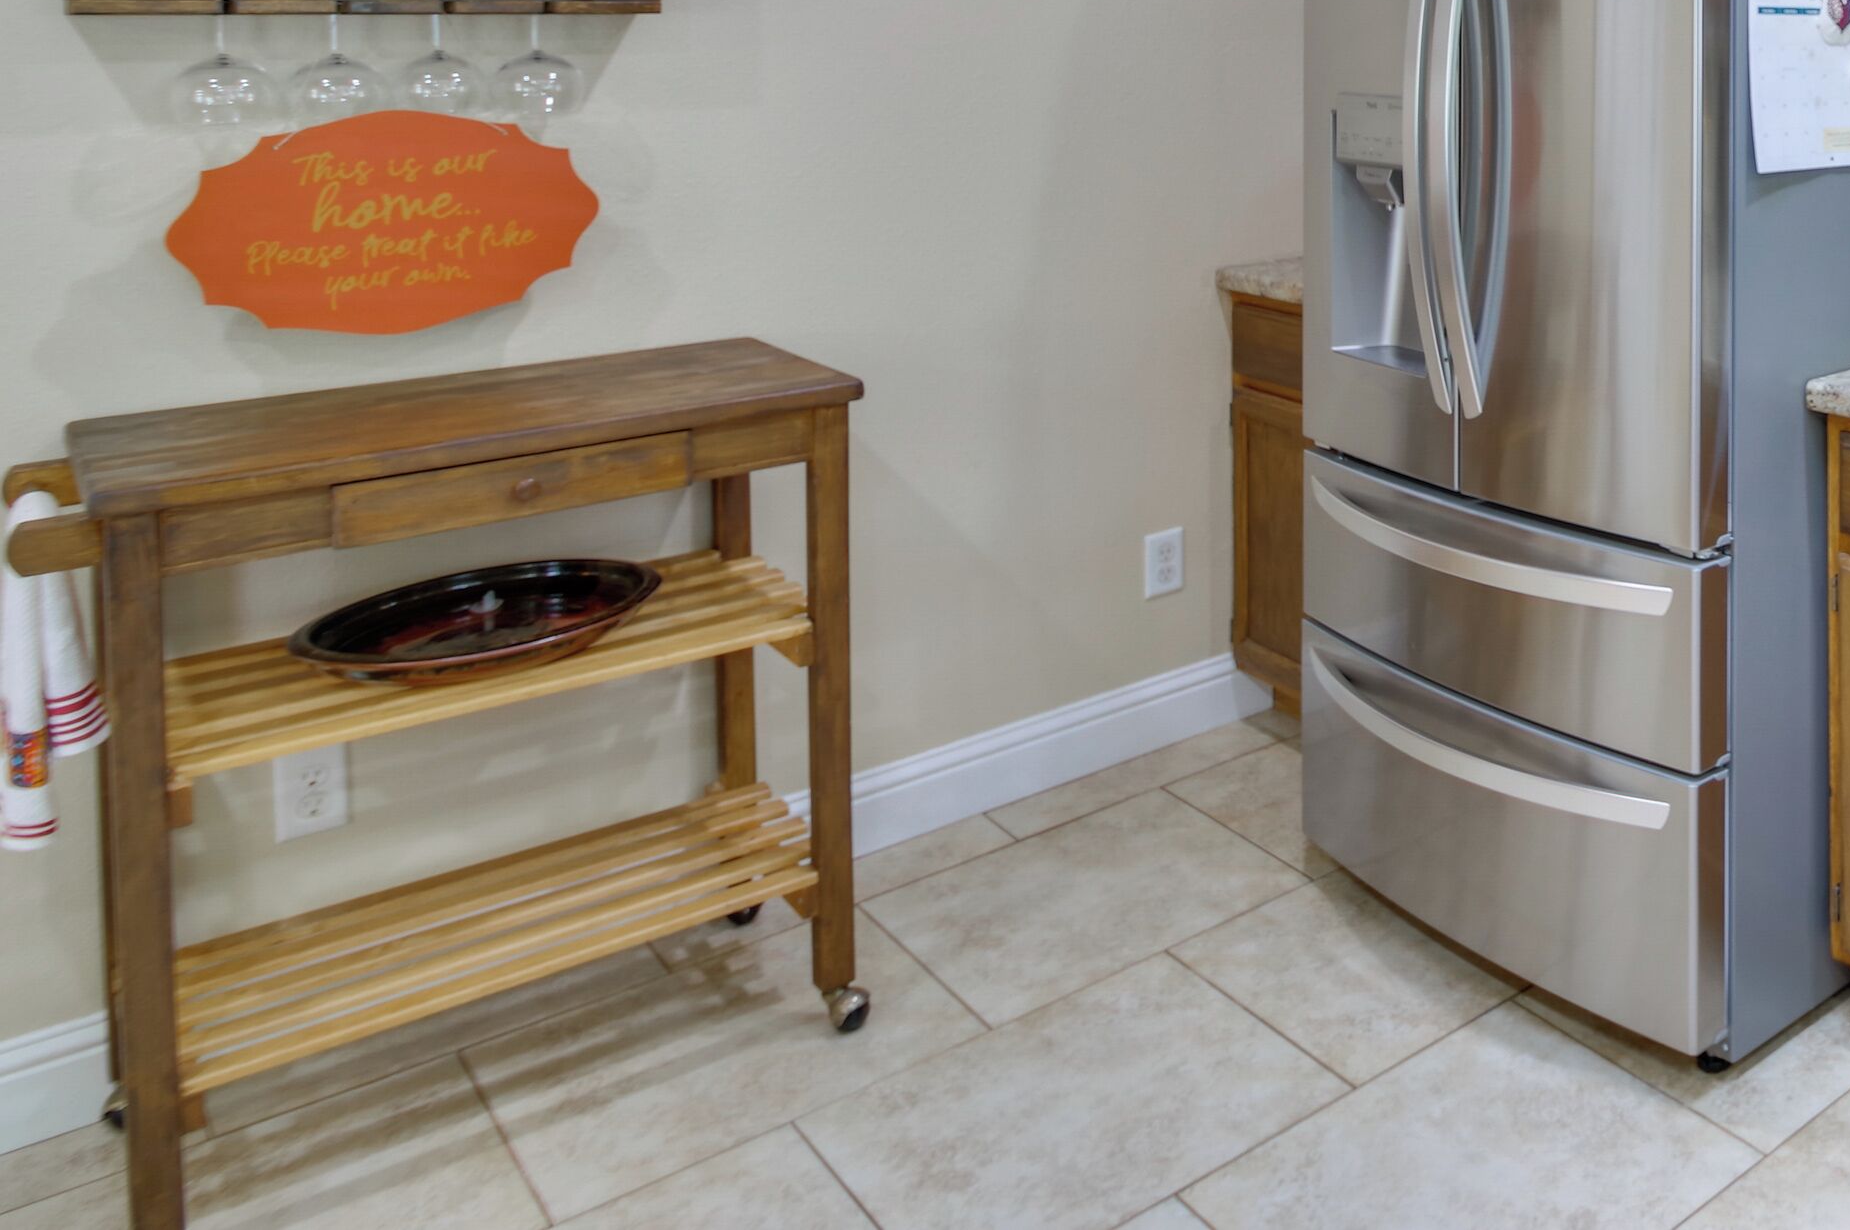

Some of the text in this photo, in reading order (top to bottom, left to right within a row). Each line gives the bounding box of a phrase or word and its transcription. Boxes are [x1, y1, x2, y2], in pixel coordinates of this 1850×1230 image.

[292, 149, 497, 186] This is our
[312, 180, 482, 234] home...
[246, 219, 538, 276] Please treat it like
[325, 265, 400, 311] your
